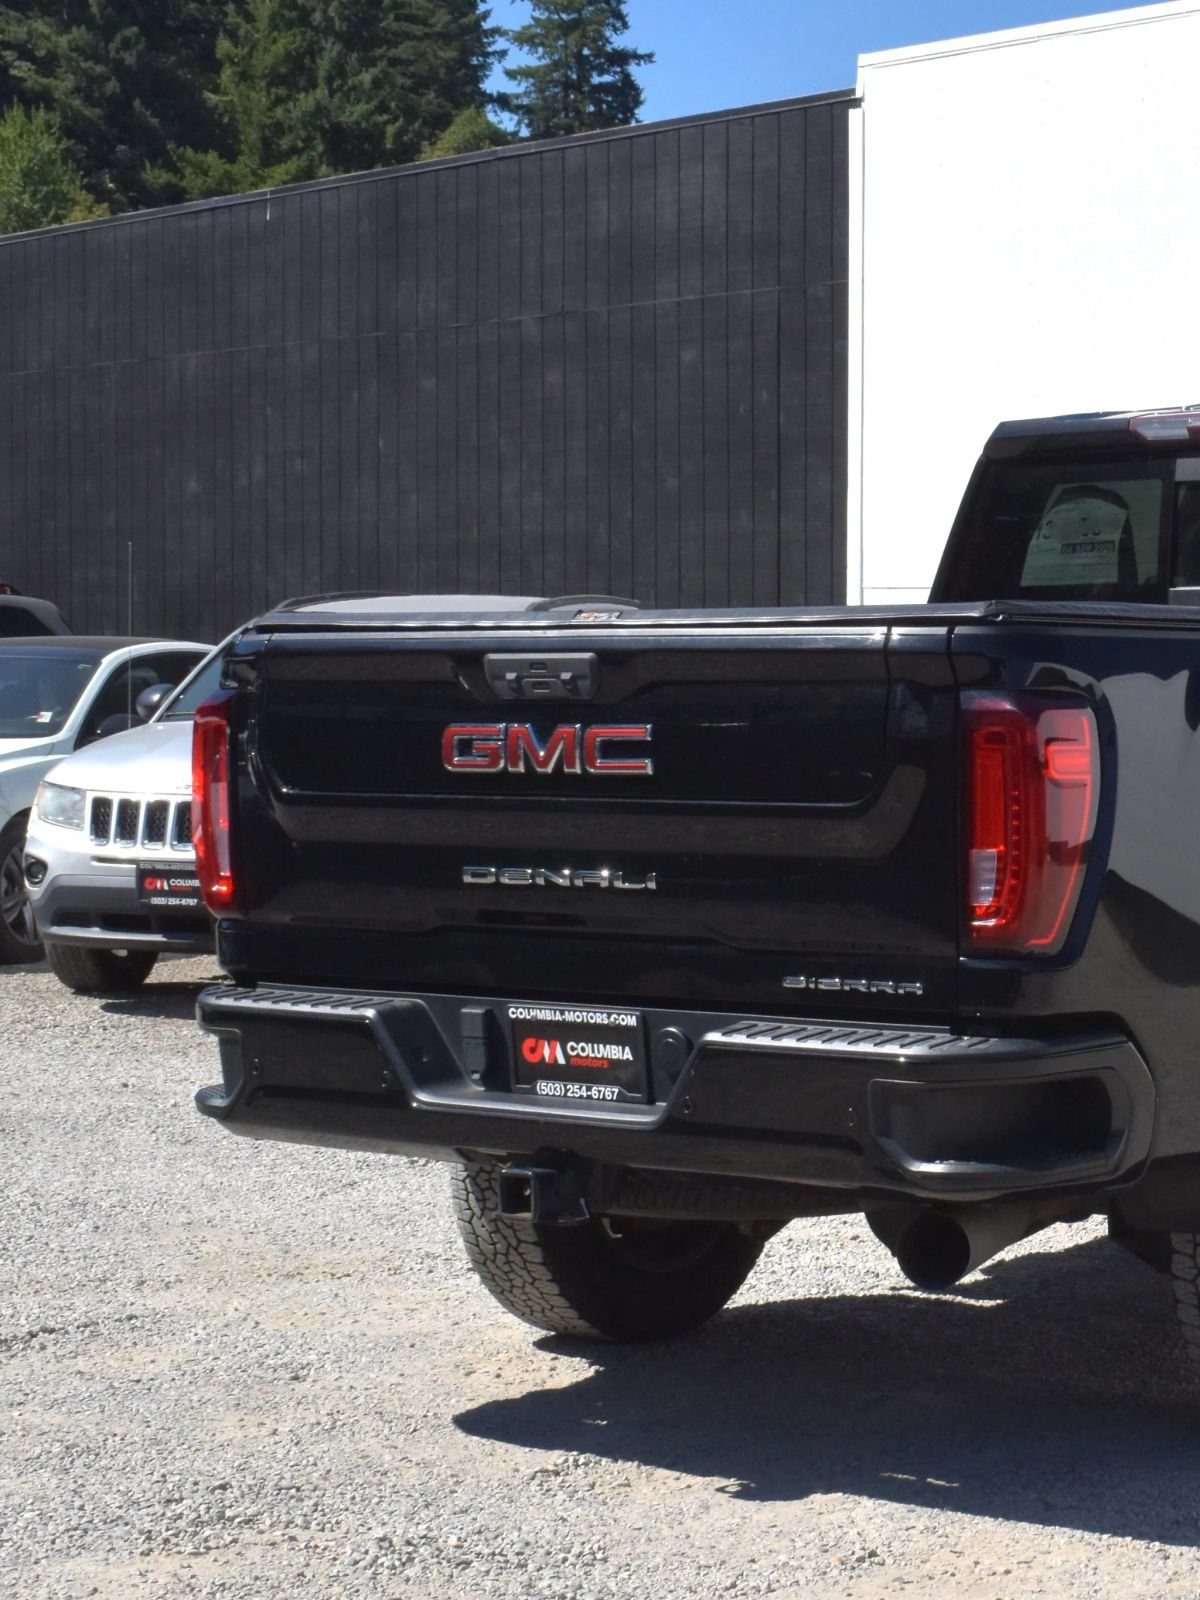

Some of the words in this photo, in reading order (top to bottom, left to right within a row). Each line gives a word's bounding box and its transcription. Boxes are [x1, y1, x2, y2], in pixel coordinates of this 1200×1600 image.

[441, 723, 653, 775] GMC
[463, 866, 657, 890] DENALI
[783, 976, 923, 995] SIERRA
[567, 1042, 634, 1061] COLUMBIA
[570, 1057, 609, 1069] motors
[536, 1083, 565, 1096] (503)
[567, 1084, 619, 1100] 254-6767
